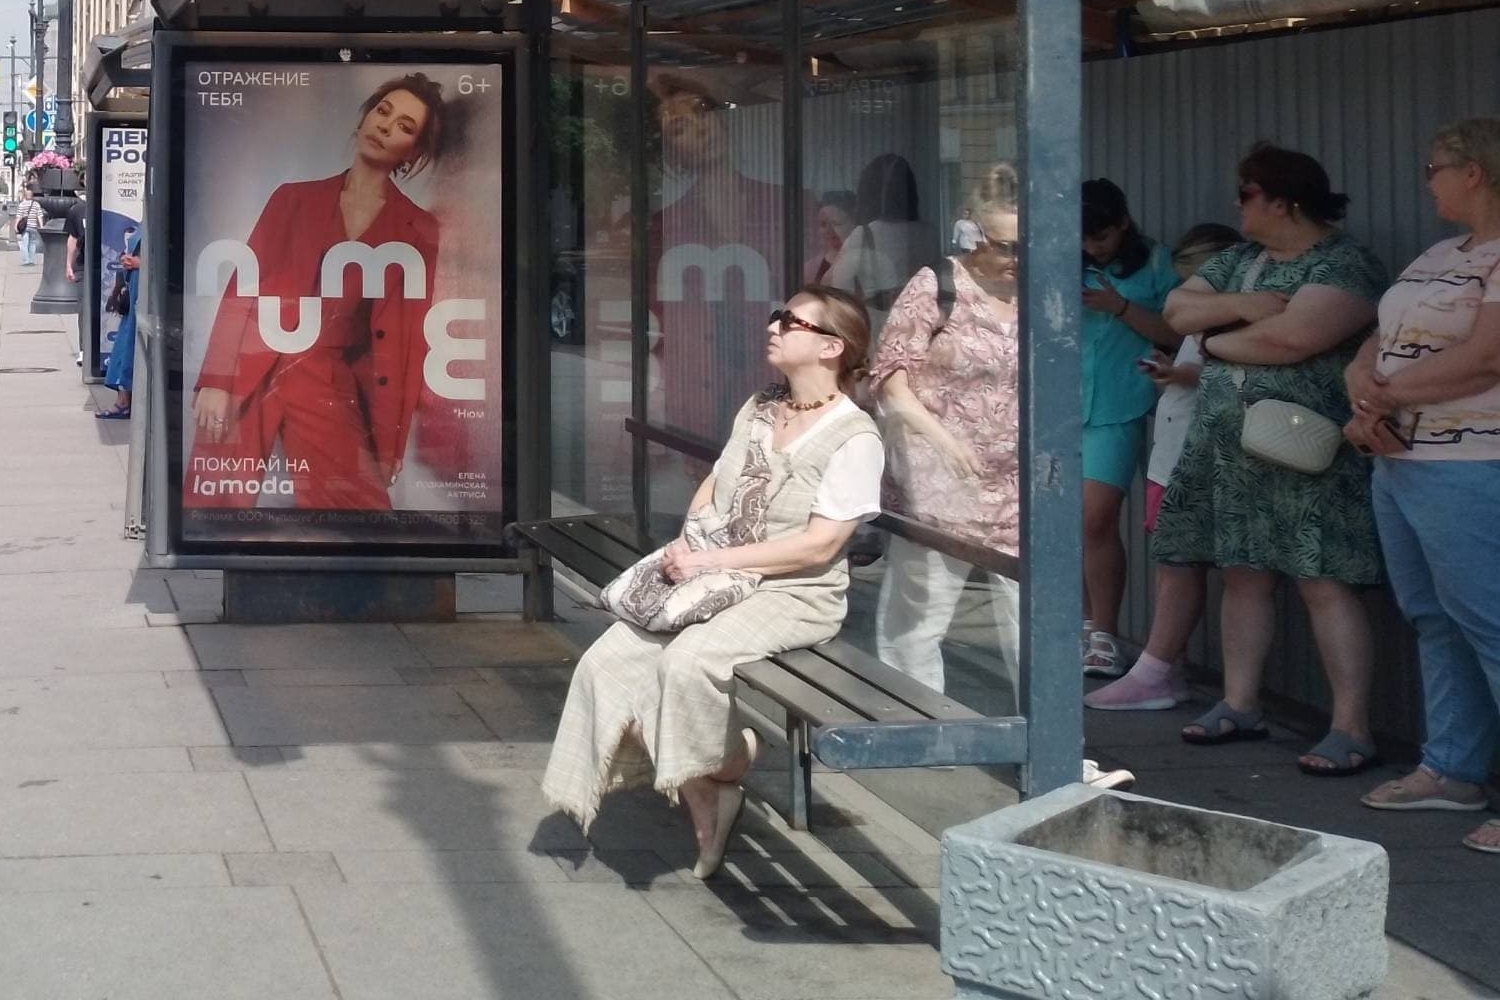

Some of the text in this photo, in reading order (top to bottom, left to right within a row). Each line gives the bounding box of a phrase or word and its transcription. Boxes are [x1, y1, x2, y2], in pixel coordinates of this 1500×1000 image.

[198, 71, 310, 86] ОТРАЖЕНИЕ
[458, 74, 492, 95] 6+
[198, 92, 243, 106] ТЕБЯ
[194, 454, 310, 472] ПОКУПАЙ НА
[458, 472, 486, 480] ЕЛЕНА
[193, 474, 294, 495] lamoda
